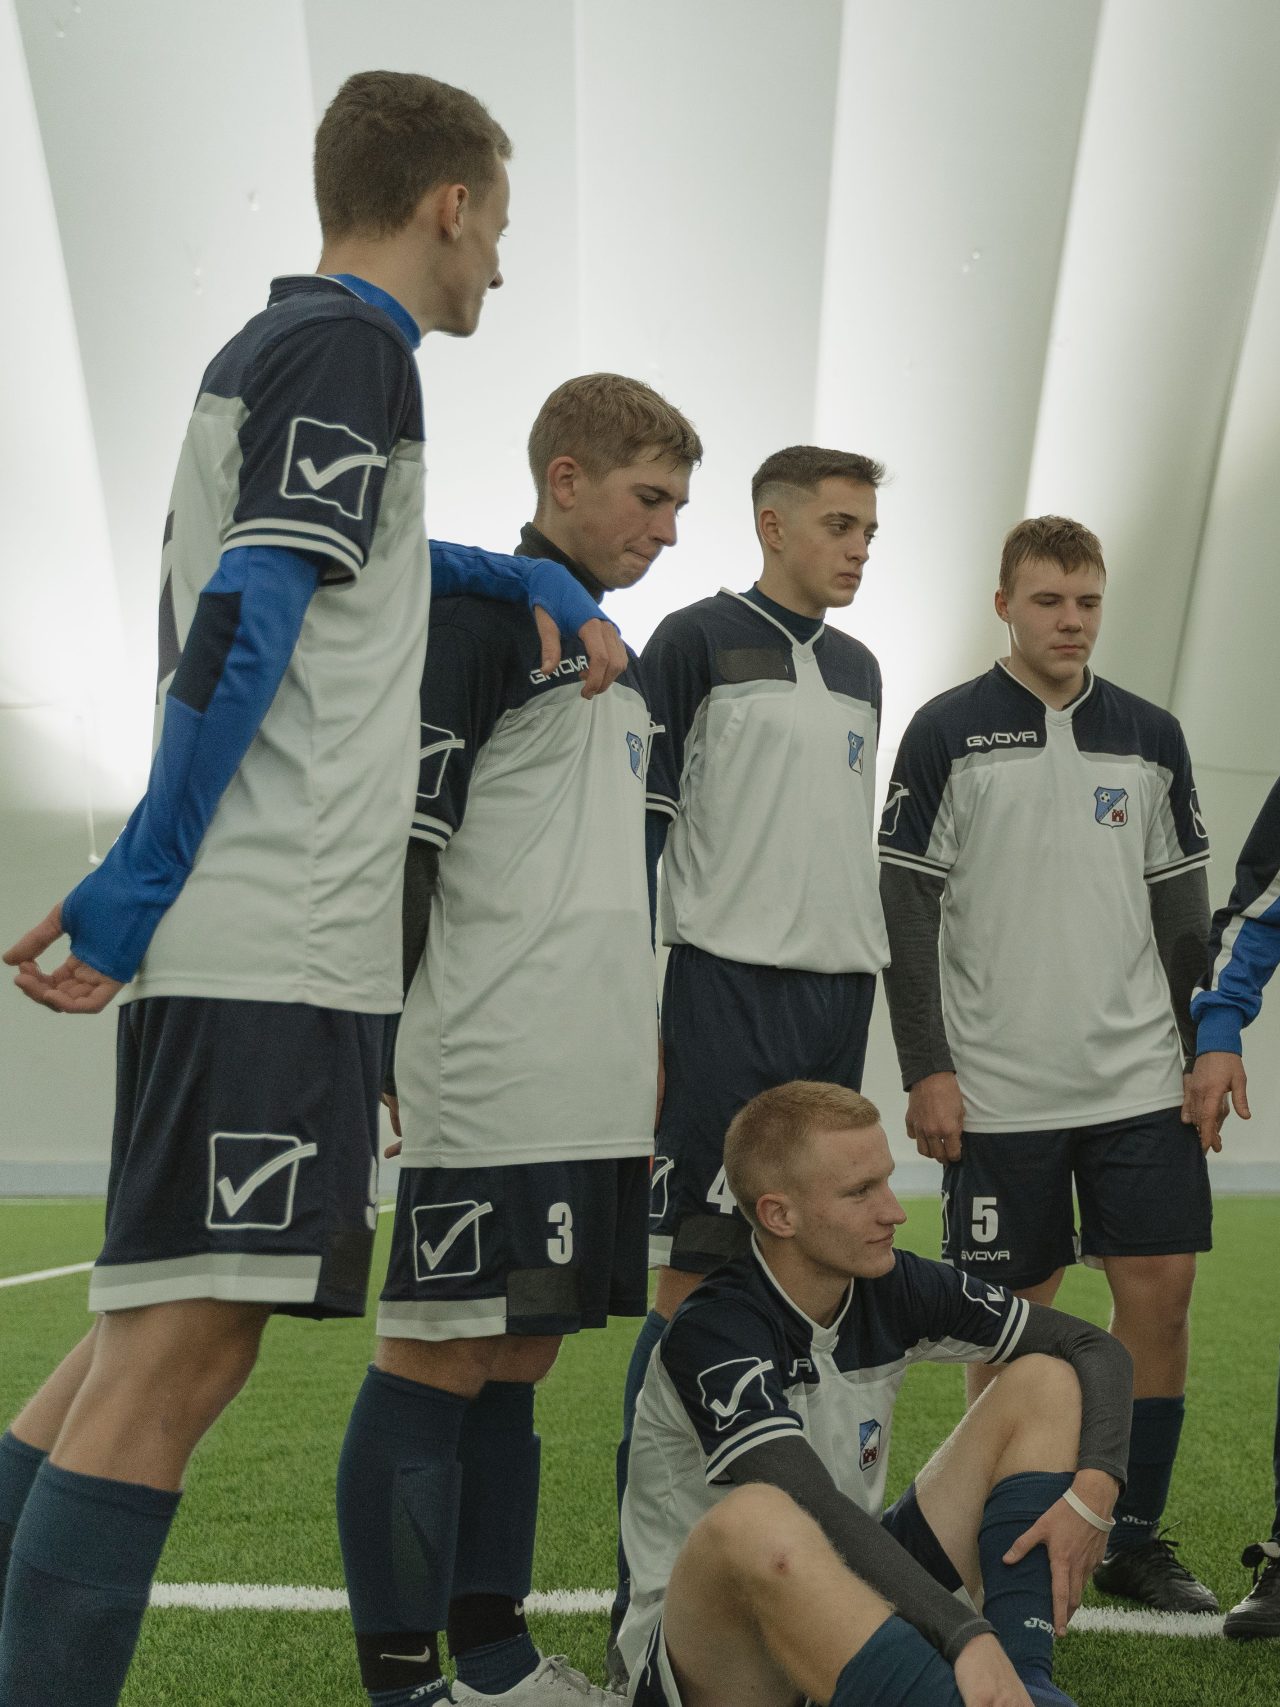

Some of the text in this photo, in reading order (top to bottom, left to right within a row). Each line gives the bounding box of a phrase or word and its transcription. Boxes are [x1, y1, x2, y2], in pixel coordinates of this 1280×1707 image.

[705, 1163, 738, 1215] 4
[547, 1201, 574, 1265] 3
[971, 1196, 999, 1243] 5
